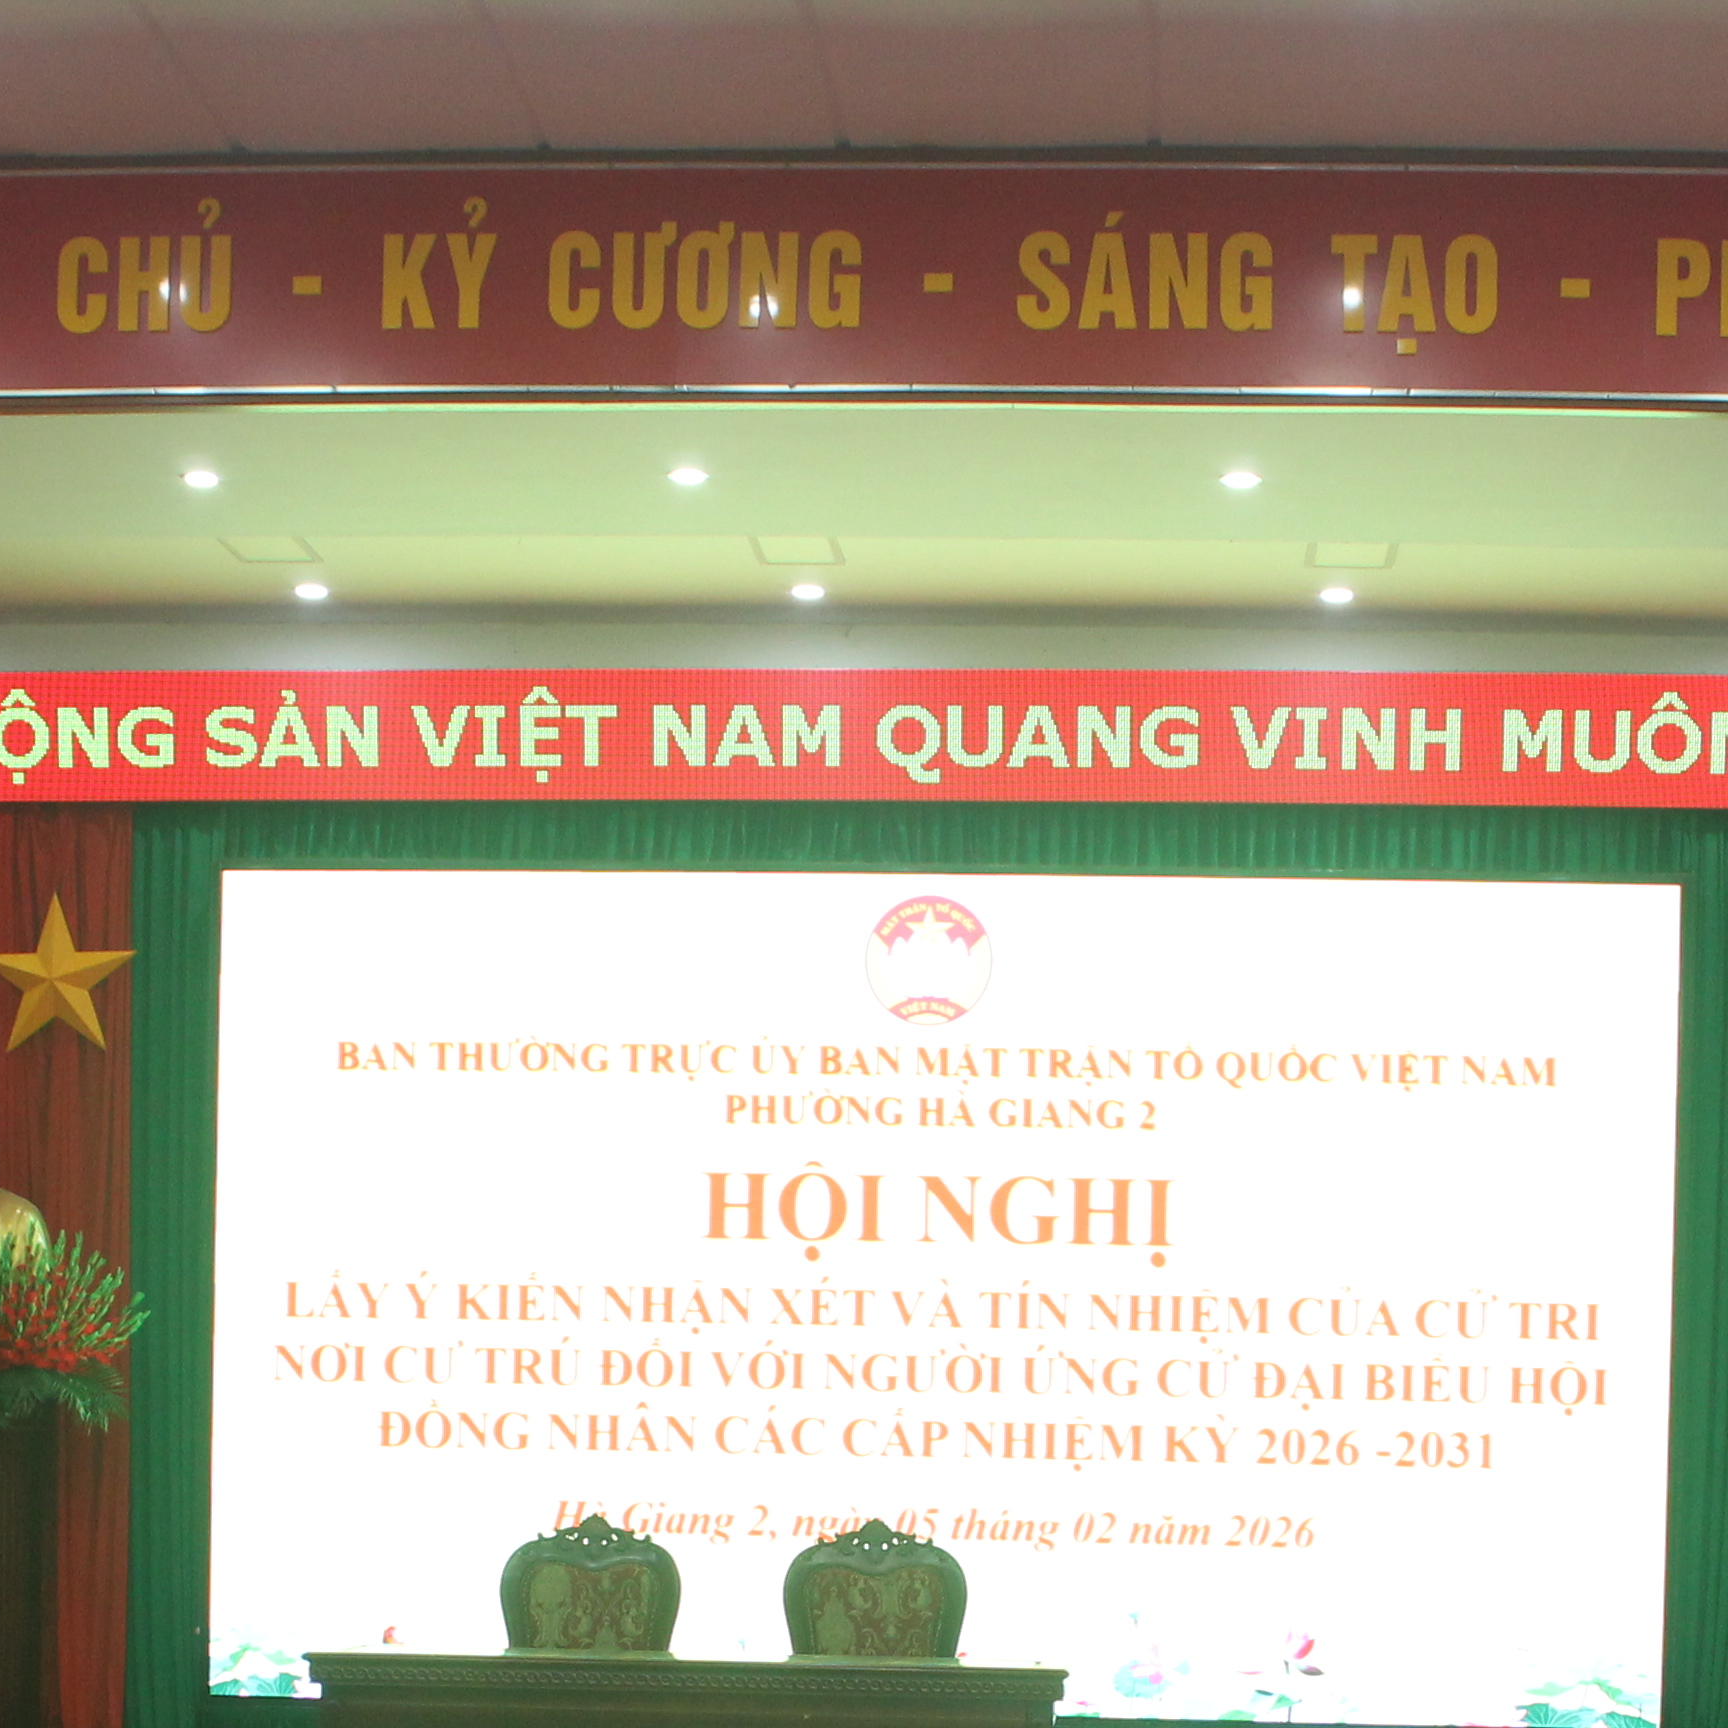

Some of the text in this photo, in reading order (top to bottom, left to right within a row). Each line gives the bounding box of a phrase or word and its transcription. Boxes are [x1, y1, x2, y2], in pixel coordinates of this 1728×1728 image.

[57, 199, 232, 334] CHỦ
[382, 198, 497, 329] KỶ
[549, 222, 862, 330] CƯƠNG
[1017, 213, 1273, 332] SÁNG
[1332, 235, 1498, 355] TẠO
[206, 691, 379, 767] SẢN
[411, 687, 617, 783] VIỆT
[654, 705, 841, 767] NAM
[876, 705, 1198, 783] QUANG
[1230, 707, 1461, 771] VINH
[338, 1042, 415, 1071] BAN
[430, 1036, 608, 1072] THƯỜNG
[622, 1041, 736, 1081] TRỰC
[820, 1046, 899, 1076] BAN
[917, 1044, 1008, 1085] MẶT
[1020, 1048, 1131, 1087] TRẬN
[1146, 1042, 1203, 1080] TỔ
[1216, 1044, 1336, 1089] QUỐC
[1352, 1051, 1448, 1092] VIỆT
[1463, 1056, 1556, 1087] NAM
[726, 1089, 1156, 1131] PHƯỜNG HÀ GIANG 2
[704, 1161, 1172, 1268] HỘI NGHỊ
[287, 1269, 1598, 1344] LẤY Ý KIẾN NHẬN XÉT VÀ TÍN NHIỆM CỦA CỬ TRI
[275, 1336, 1606, 1416] NƠI CƯ TRÚ ĐỐI VỚI NGƯỜI ỨNG CỬ ĐẠI BIỂU HỘI
[380, 1400, 1491, 1471] ĐỒNG NHÂN CÁC CẤP NHIỆM KỲ 2026 -2031
[622, 1502, 736, 1544] Giang
[747, 1505, 776, 1542] 2,
[896, 1508, 940, 1540] 05
[951, 1508, 1059, 1551] tháng
[1073, 1512, 1116, 1544] 02
[1129, 1515, 1210, 1546] năm
[1224, 1515, 1316, 1548] 2026
